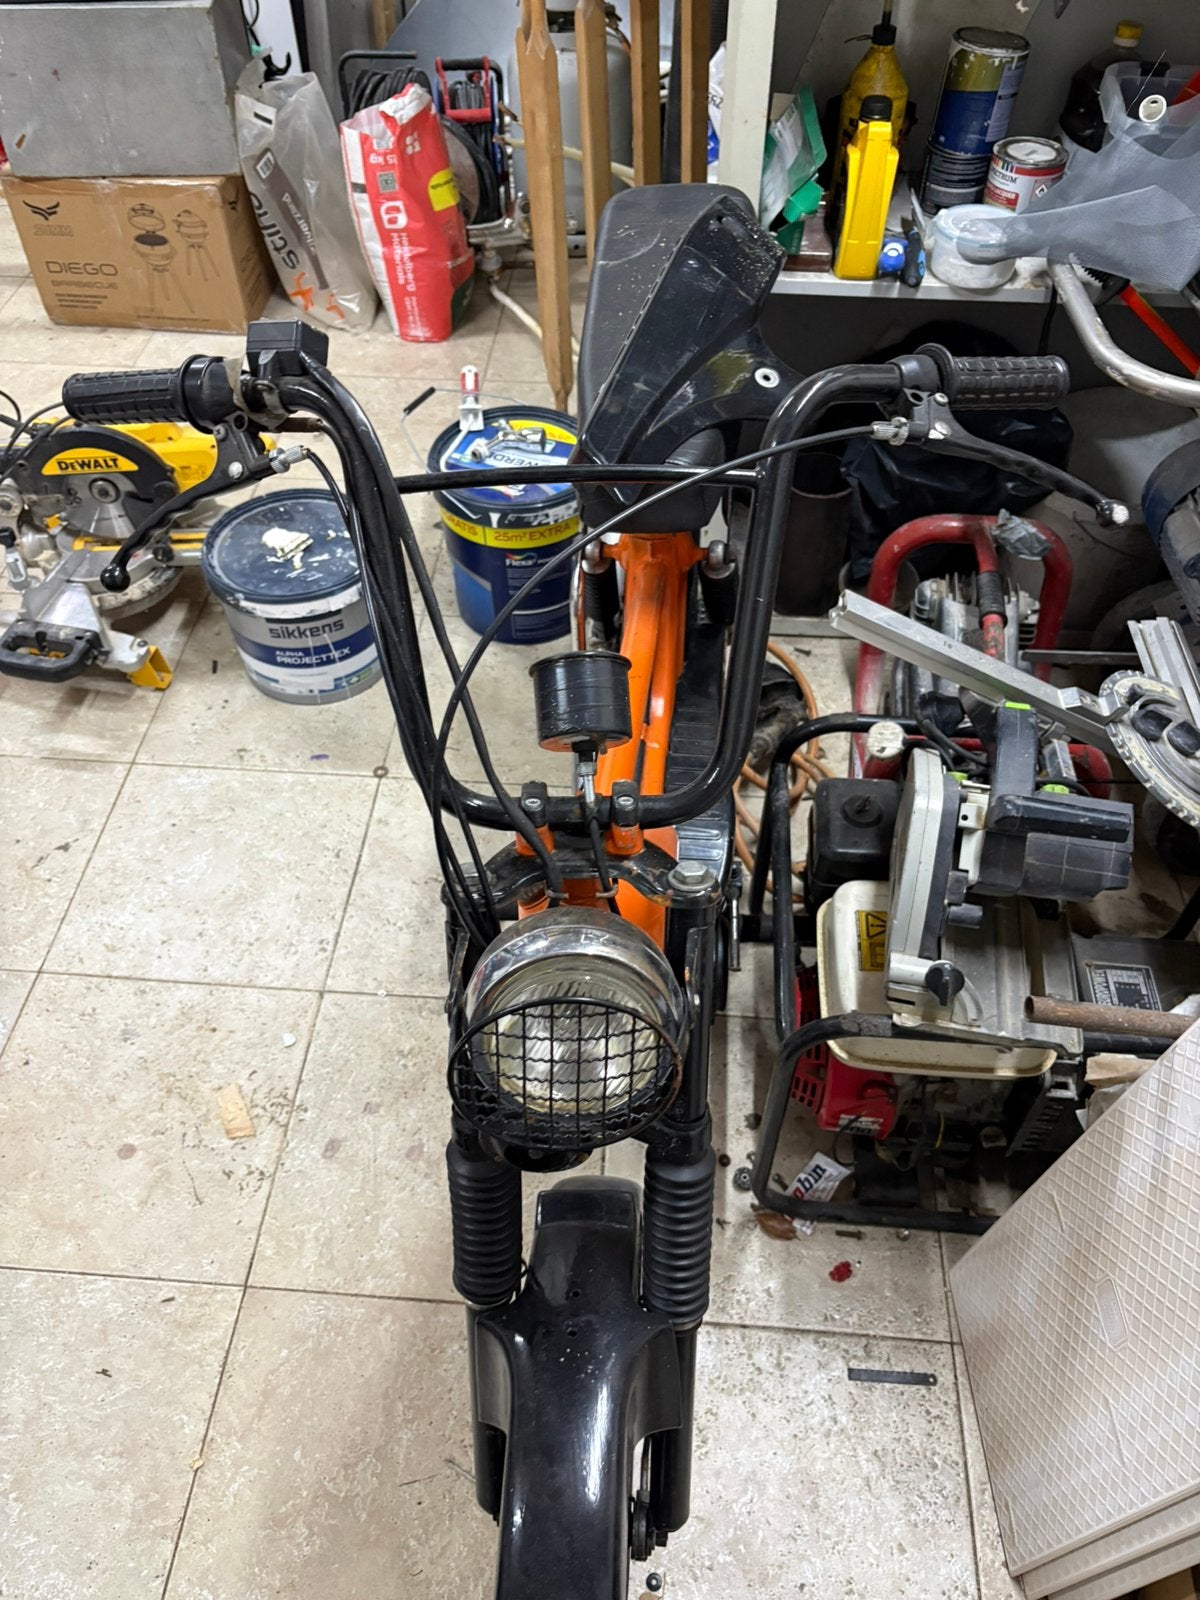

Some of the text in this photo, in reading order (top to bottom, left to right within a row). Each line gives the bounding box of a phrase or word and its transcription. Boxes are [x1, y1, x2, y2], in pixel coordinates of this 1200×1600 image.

[45, 260, 119, 277] DIEGO
[390, 232, 406, 285] Materials
[400, 232, 417, 292] Heidelberg
[528, 522, 572, 541] EXTRA
[268, 619, 345, 640] sikkens
[275, 650, 305, 658] ALPHA
[276, 646, 352, 666] PROJECTTEX
[792, 1163, 828, 1200] obin
